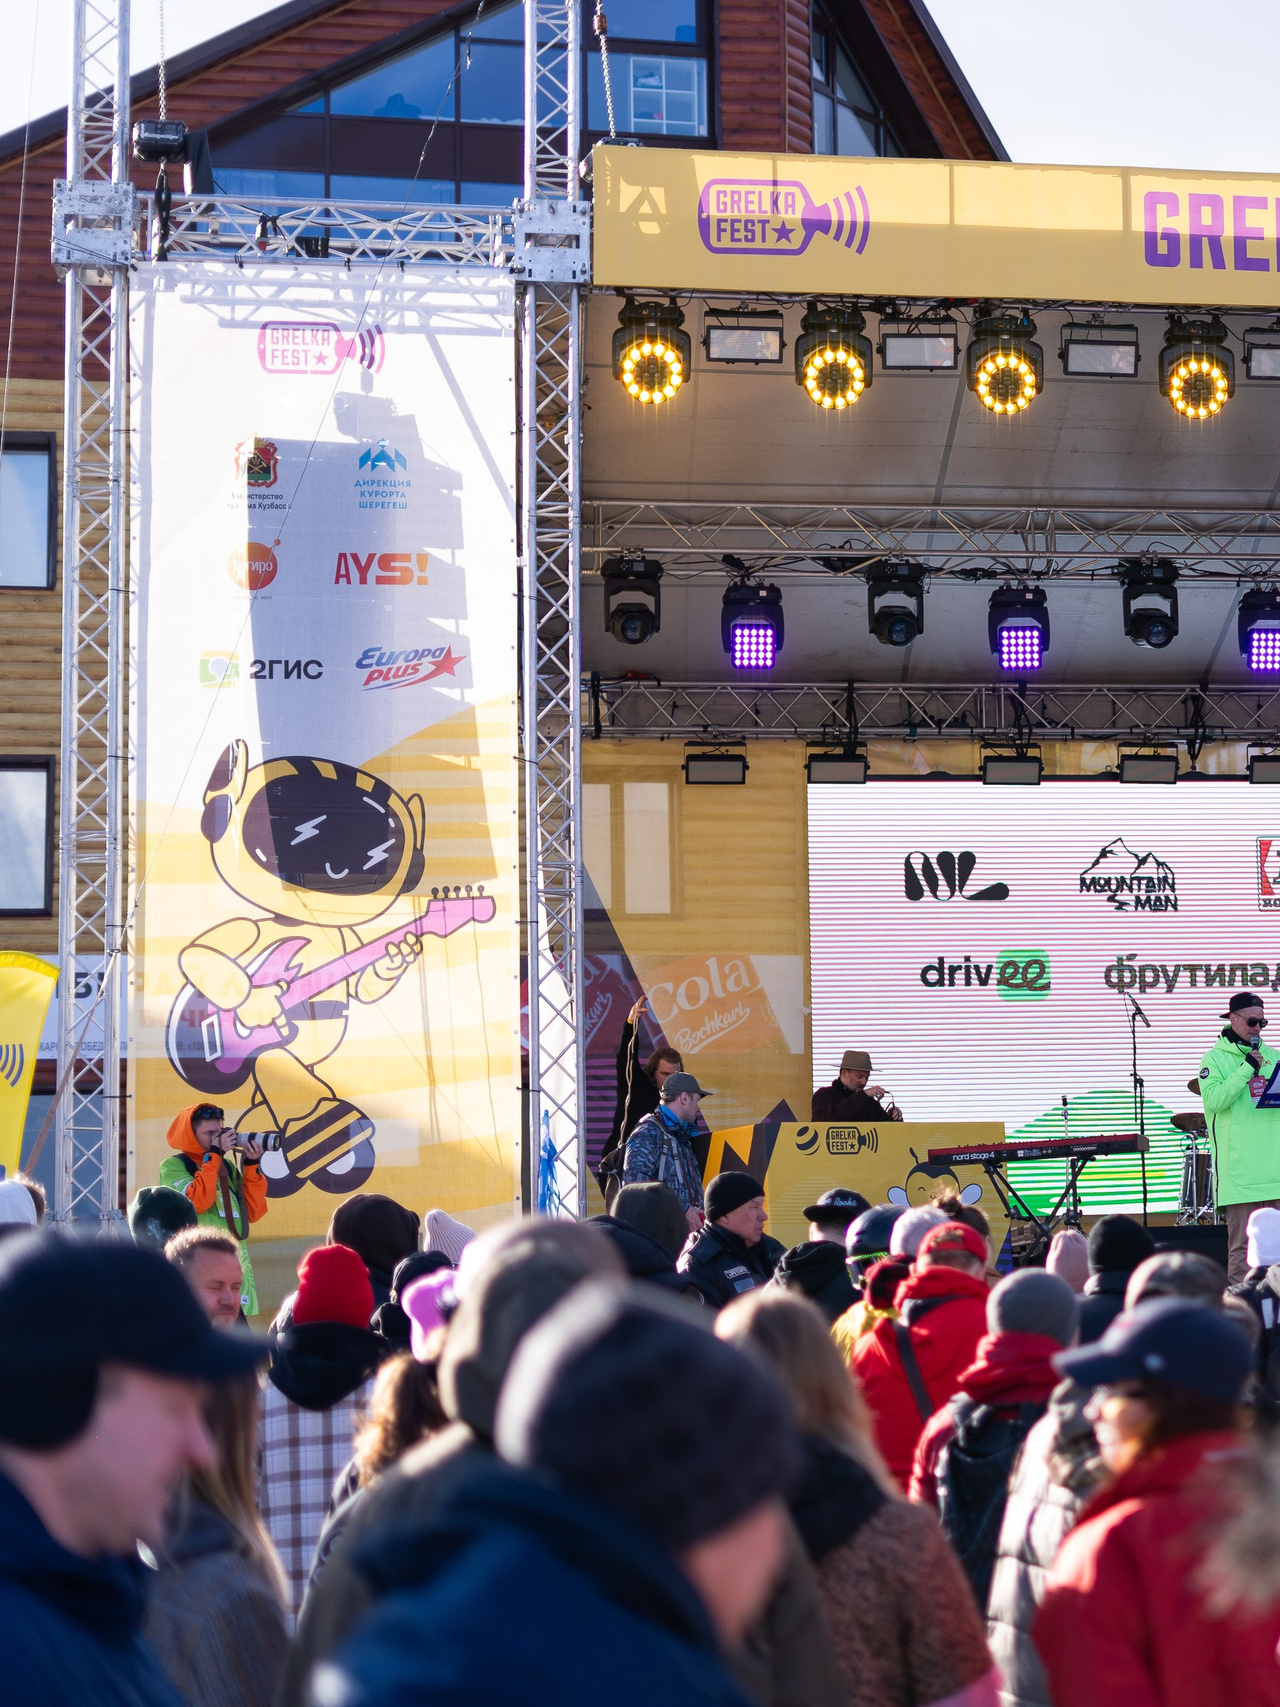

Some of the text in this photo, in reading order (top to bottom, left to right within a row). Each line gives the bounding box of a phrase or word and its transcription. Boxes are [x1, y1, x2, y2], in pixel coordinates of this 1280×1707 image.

[716, 189, 796, 216] GRELKA
[716, 218, 770, 244] FEST
[270, 327, 331, 347] GRELKA
[270, 348, 309, 367] FEST
[354, 479, 411, 488] ДИРЕКЦИЯ
[360, 490, 407, 498] КУРОРТА
[257, 501, 292, 511] Кузбасса
[358, 501, 408, 509] ШЕРЕГЕШ
[334, 552, 429, 585] AYS!
[249, 659, 324, 680] 2ГИС
[1079, 875, 1177, 894] MOUNTAIN
[1133, 894, 1179, 912] MAN
[919, 955, 1052, 991] drivee
[647, 956, 753, 1025] Cola
[674, 1001, 750, 1053] Bochkari
[830, 1130, 857, 1140] GRELKA
[831, 1141, 849, 1151] FEST
[953, 1151, 995, 1161] nord stage 4
